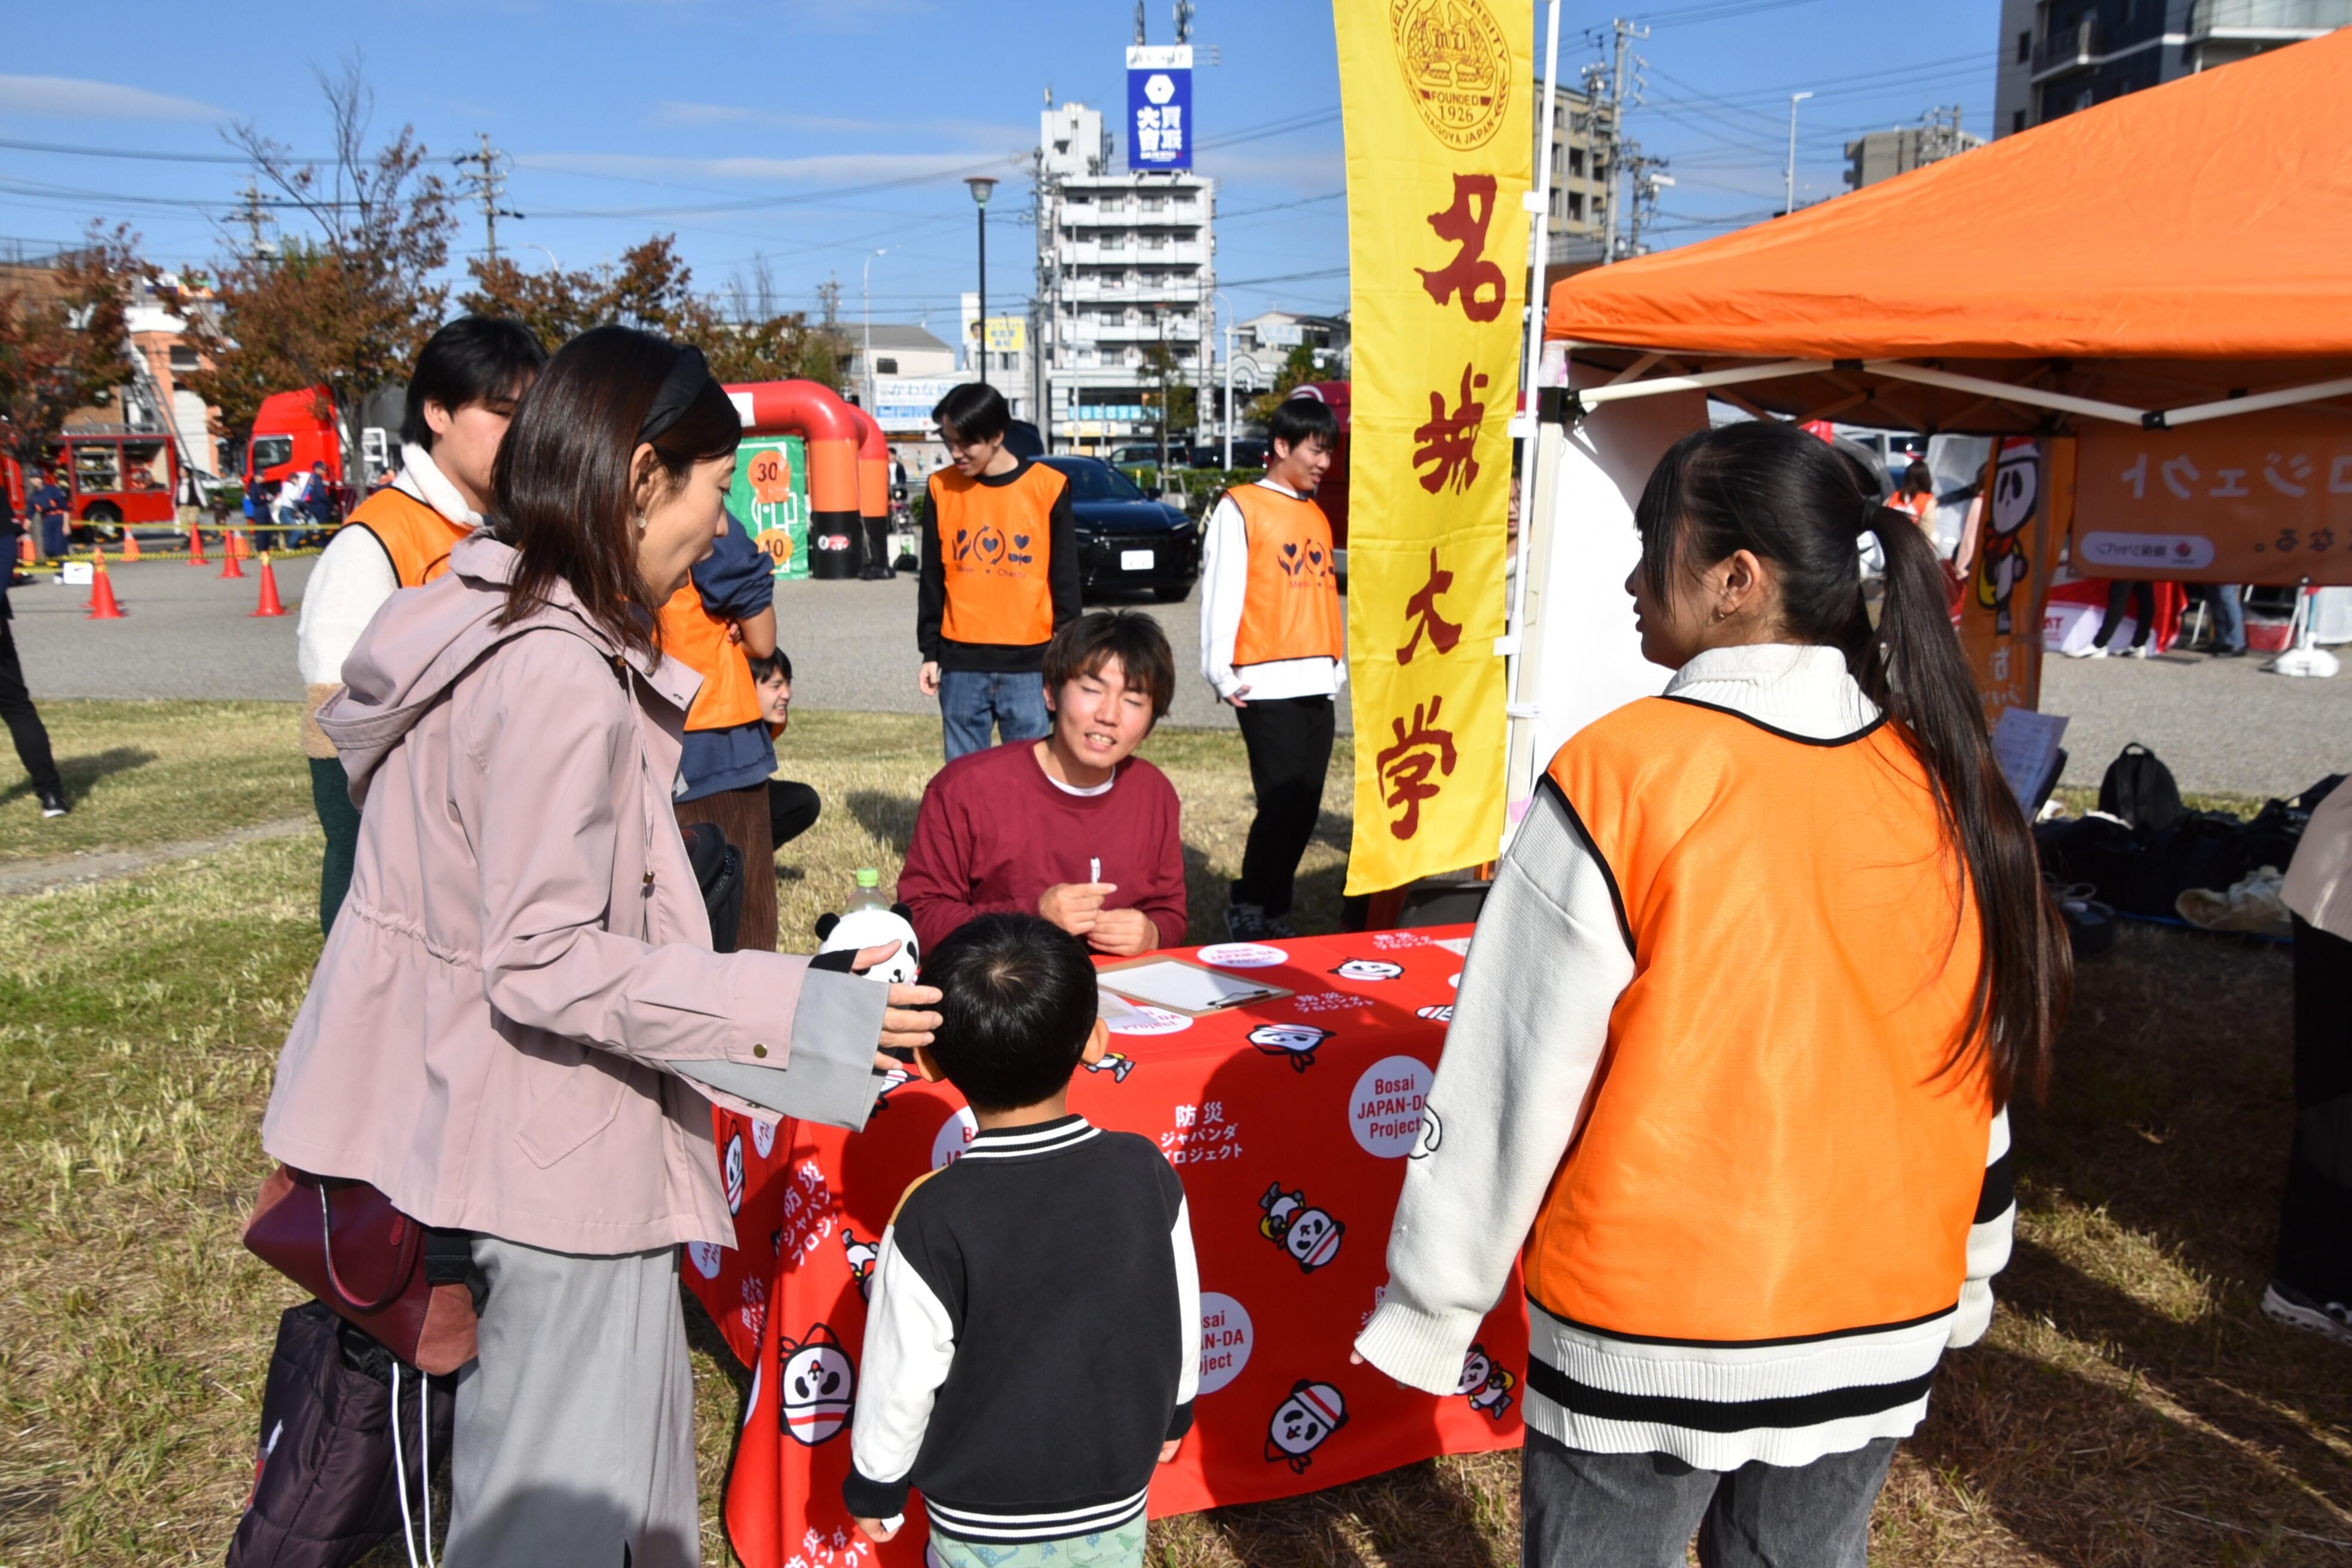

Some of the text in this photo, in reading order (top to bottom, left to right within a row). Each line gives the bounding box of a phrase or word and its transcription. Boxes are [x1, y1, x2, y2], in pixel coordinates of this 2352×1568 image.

[1470, 0, 1506, 63] RSITY
[1431, 91, 1479, 106] FOUNDED
[1438, 105, 1474, 122] 1926
[1424, 111, 1494, 145] NAGOYA JAPAN
[757, 462, 778, 482] 30
[1377, 172, 1506, 841] 名城大学
[997, 568, 1027, 580] Charity
[1375, 1074, 1414, 1095] Bosai
[1175, 1101, 1224, 1128] 防災
[1160, 1123, 1238, 1147] ジャパンダ
[1370, 1117, 1421, 1139] Project
[1202, 1310, 1225, 1329] sai
